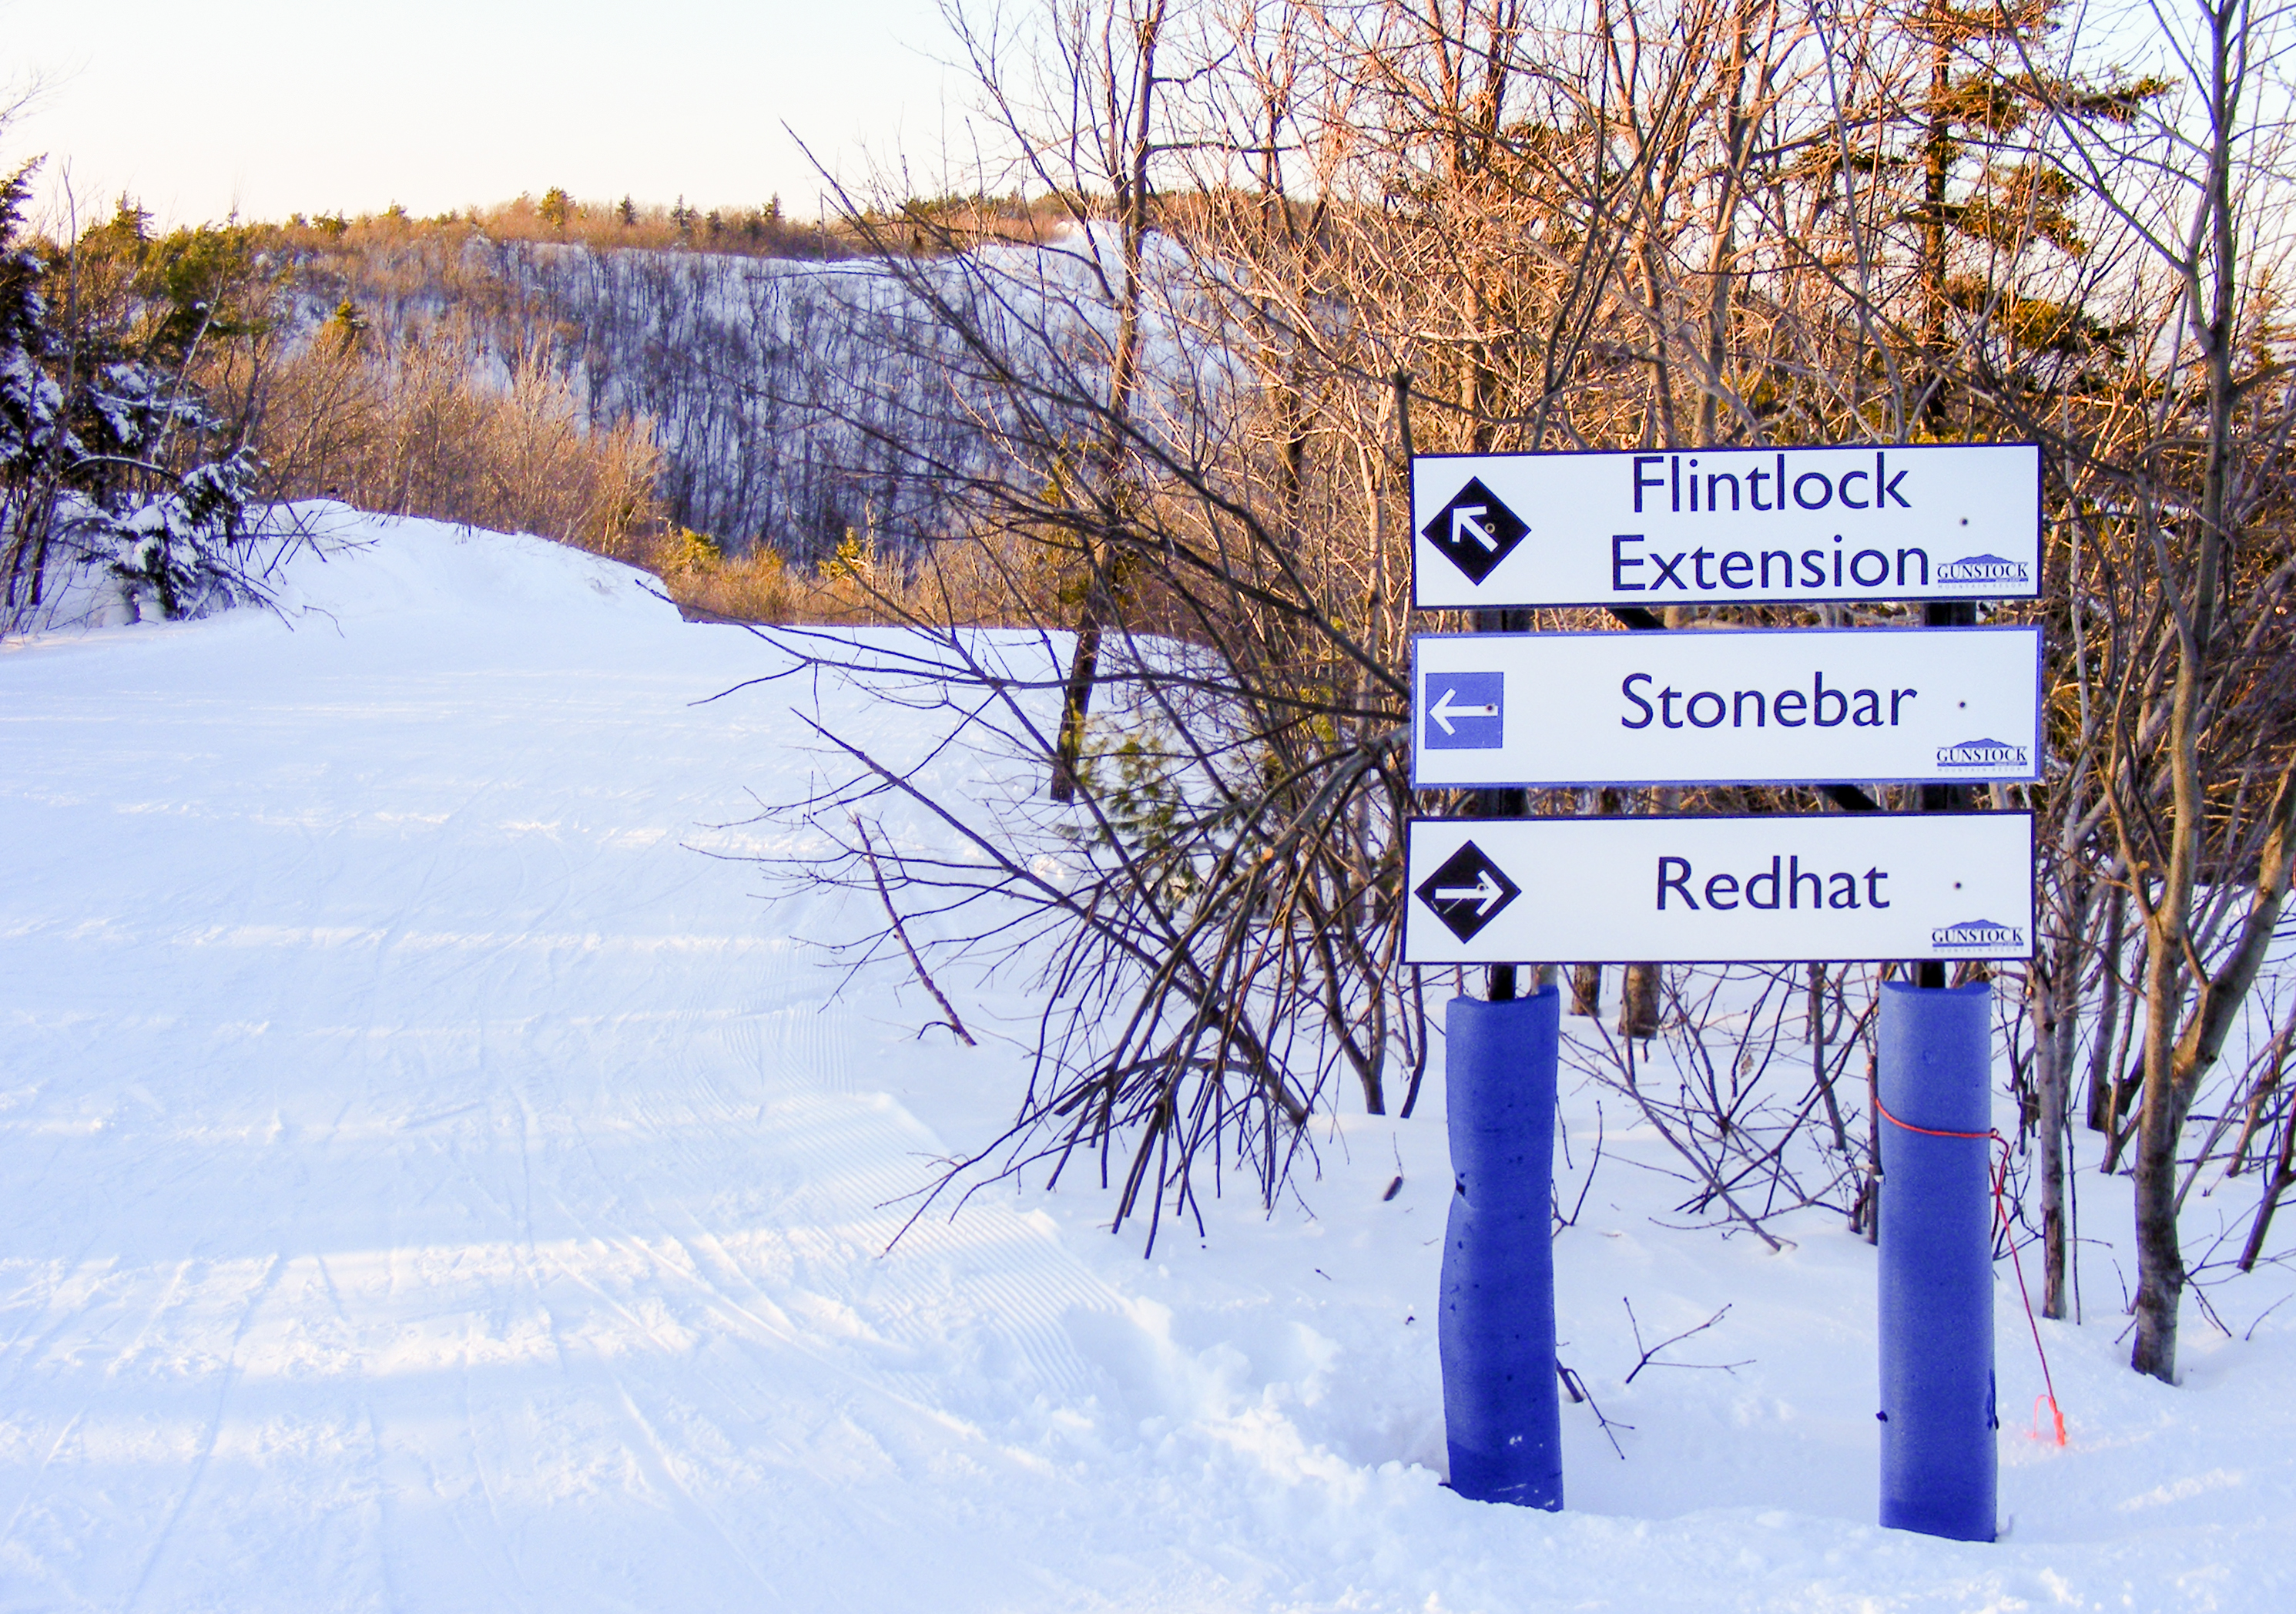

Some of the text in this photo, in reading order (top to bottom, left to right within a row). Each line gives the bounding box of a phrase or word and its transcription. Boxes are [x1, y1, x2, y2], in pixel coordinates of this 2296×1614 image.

[1633, 451, 1912, 513] Flintlock
[1612, 534, 1929, 591] Extension
[1937, 564, 2028, 579] GUNSTOCK
[1621, 671, 1918, 730] Stonebar
[1937, 748, 2027, 762] GUNSTOCK
[1657, 855, 1890, 911] Redhat
[1932, 929, 2023, 943] GUNSTOCK
